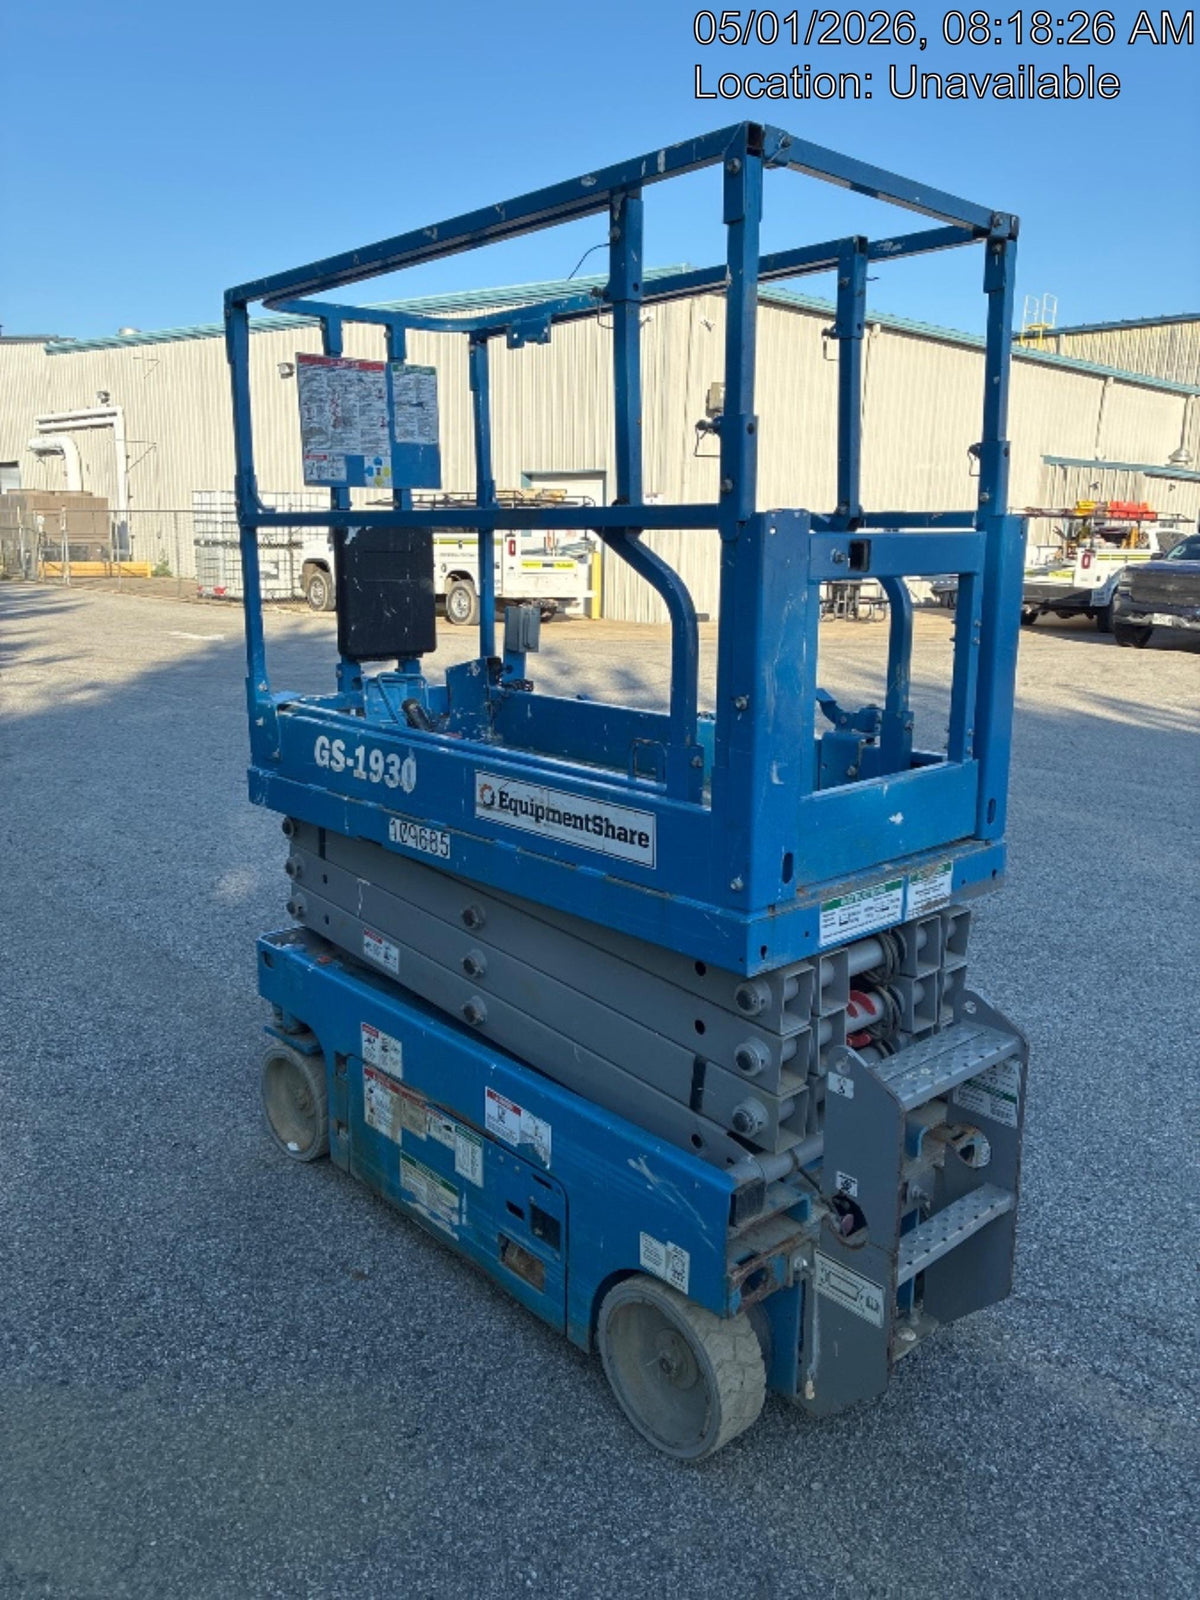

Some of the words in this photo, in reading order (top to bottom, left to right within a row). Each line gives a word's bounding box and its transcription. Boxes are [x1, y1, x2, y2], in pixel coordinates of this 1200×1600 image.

[314, 735, 417, 794] GS-1930
[390, 819, 449, 857] 109685
[499, 790, 650, 848] EquipmentShare
